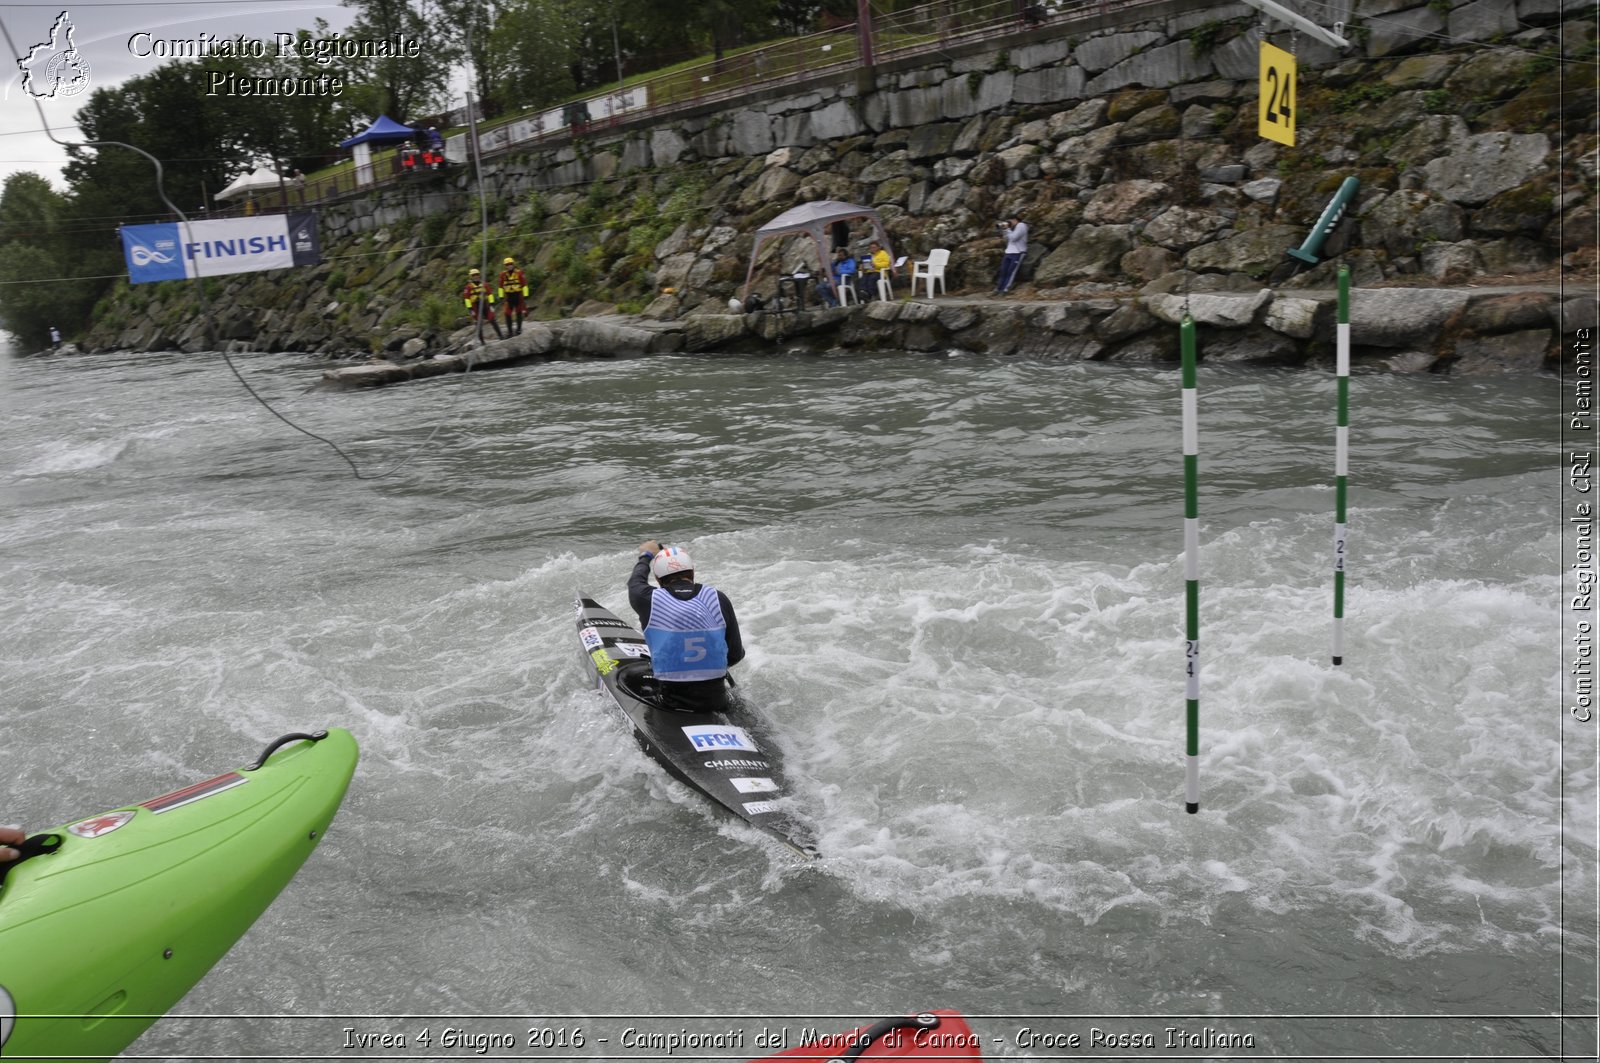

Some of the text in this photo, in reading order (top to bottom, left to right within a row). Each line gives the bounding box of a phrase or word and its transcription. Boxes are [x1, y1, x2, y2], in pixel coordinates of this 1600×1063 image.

[1266, 66, 1291, 128] 24
[185, 234, 287, 260] FINISH
[684, 637, 707, 662] 5
[691, 733, 743, 748] FFCK
